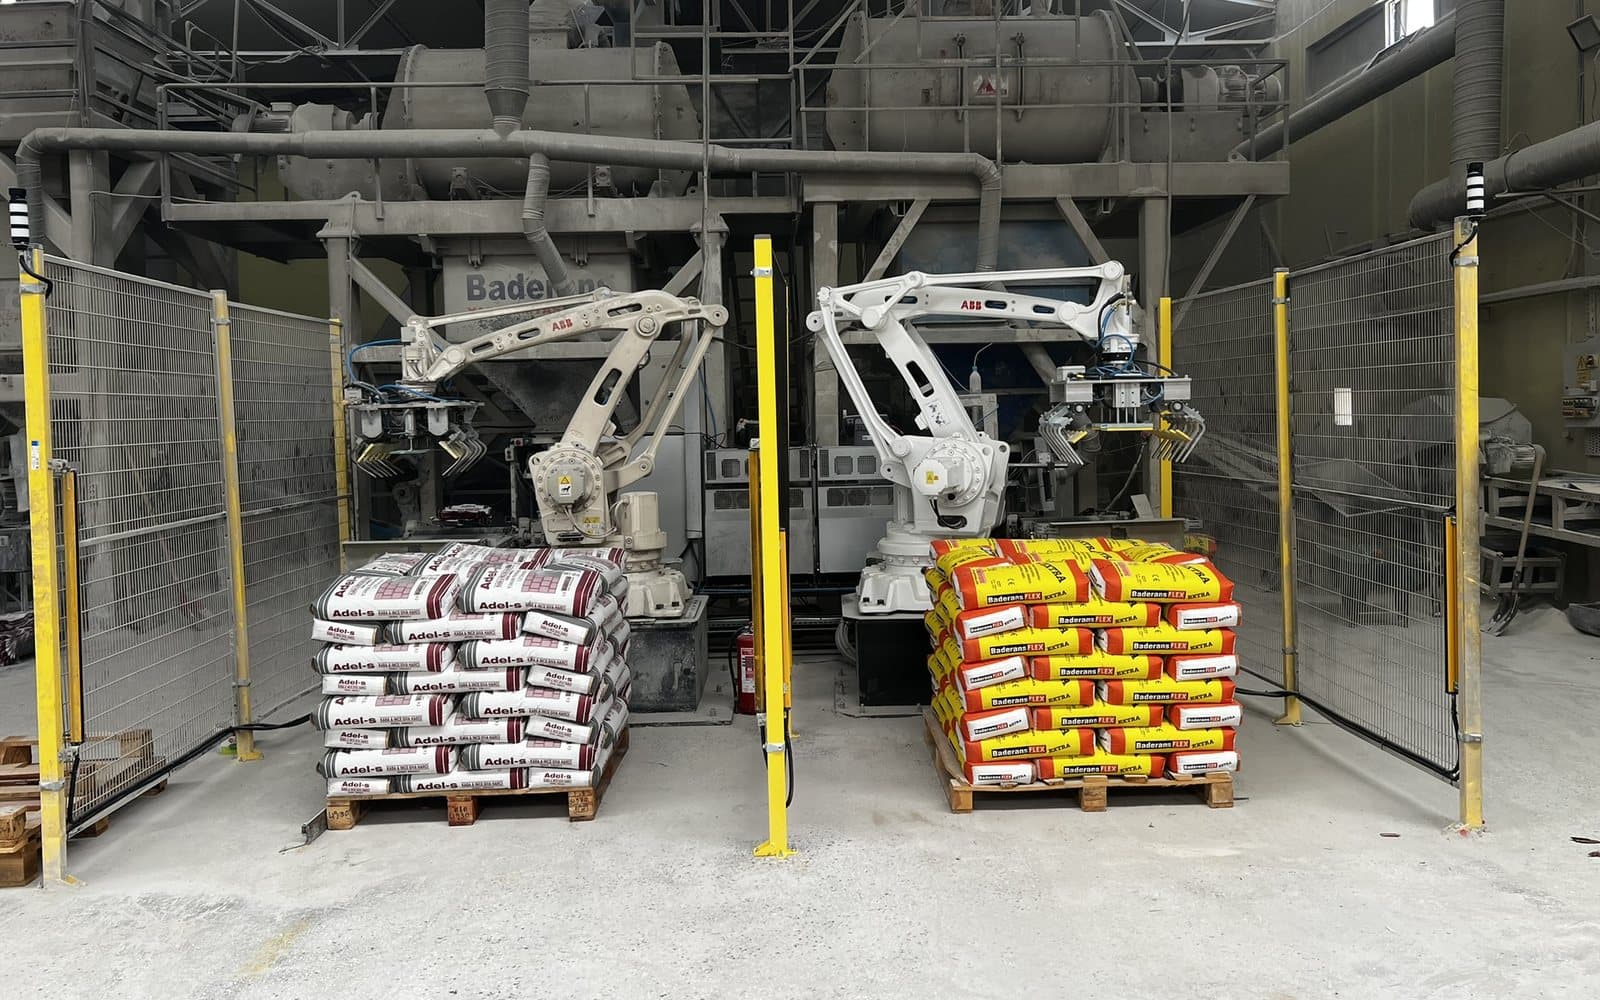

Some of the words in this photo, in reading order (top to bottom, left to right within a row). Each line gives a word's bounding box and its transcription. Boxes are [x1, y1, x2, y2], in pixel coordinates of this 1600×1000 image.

[961, 300, 982, 310] ABB
[552, 318, 574, 332] ABB
[480, 601, 522, 610] Adel-s
[408, 631, 450, 641] Adel-s
[333, 662, 375, 671] Adel-s
[413, 682, 455, 692] Adel-s
[334, 717, 376, 726] Adel-s
[414, 736, 456, 745] Adel-s
[484, 758, 526, 766] Adel-s
[341, 766, 383, 775] Adel-s
[416, 782, 458, 790] Adel-s
